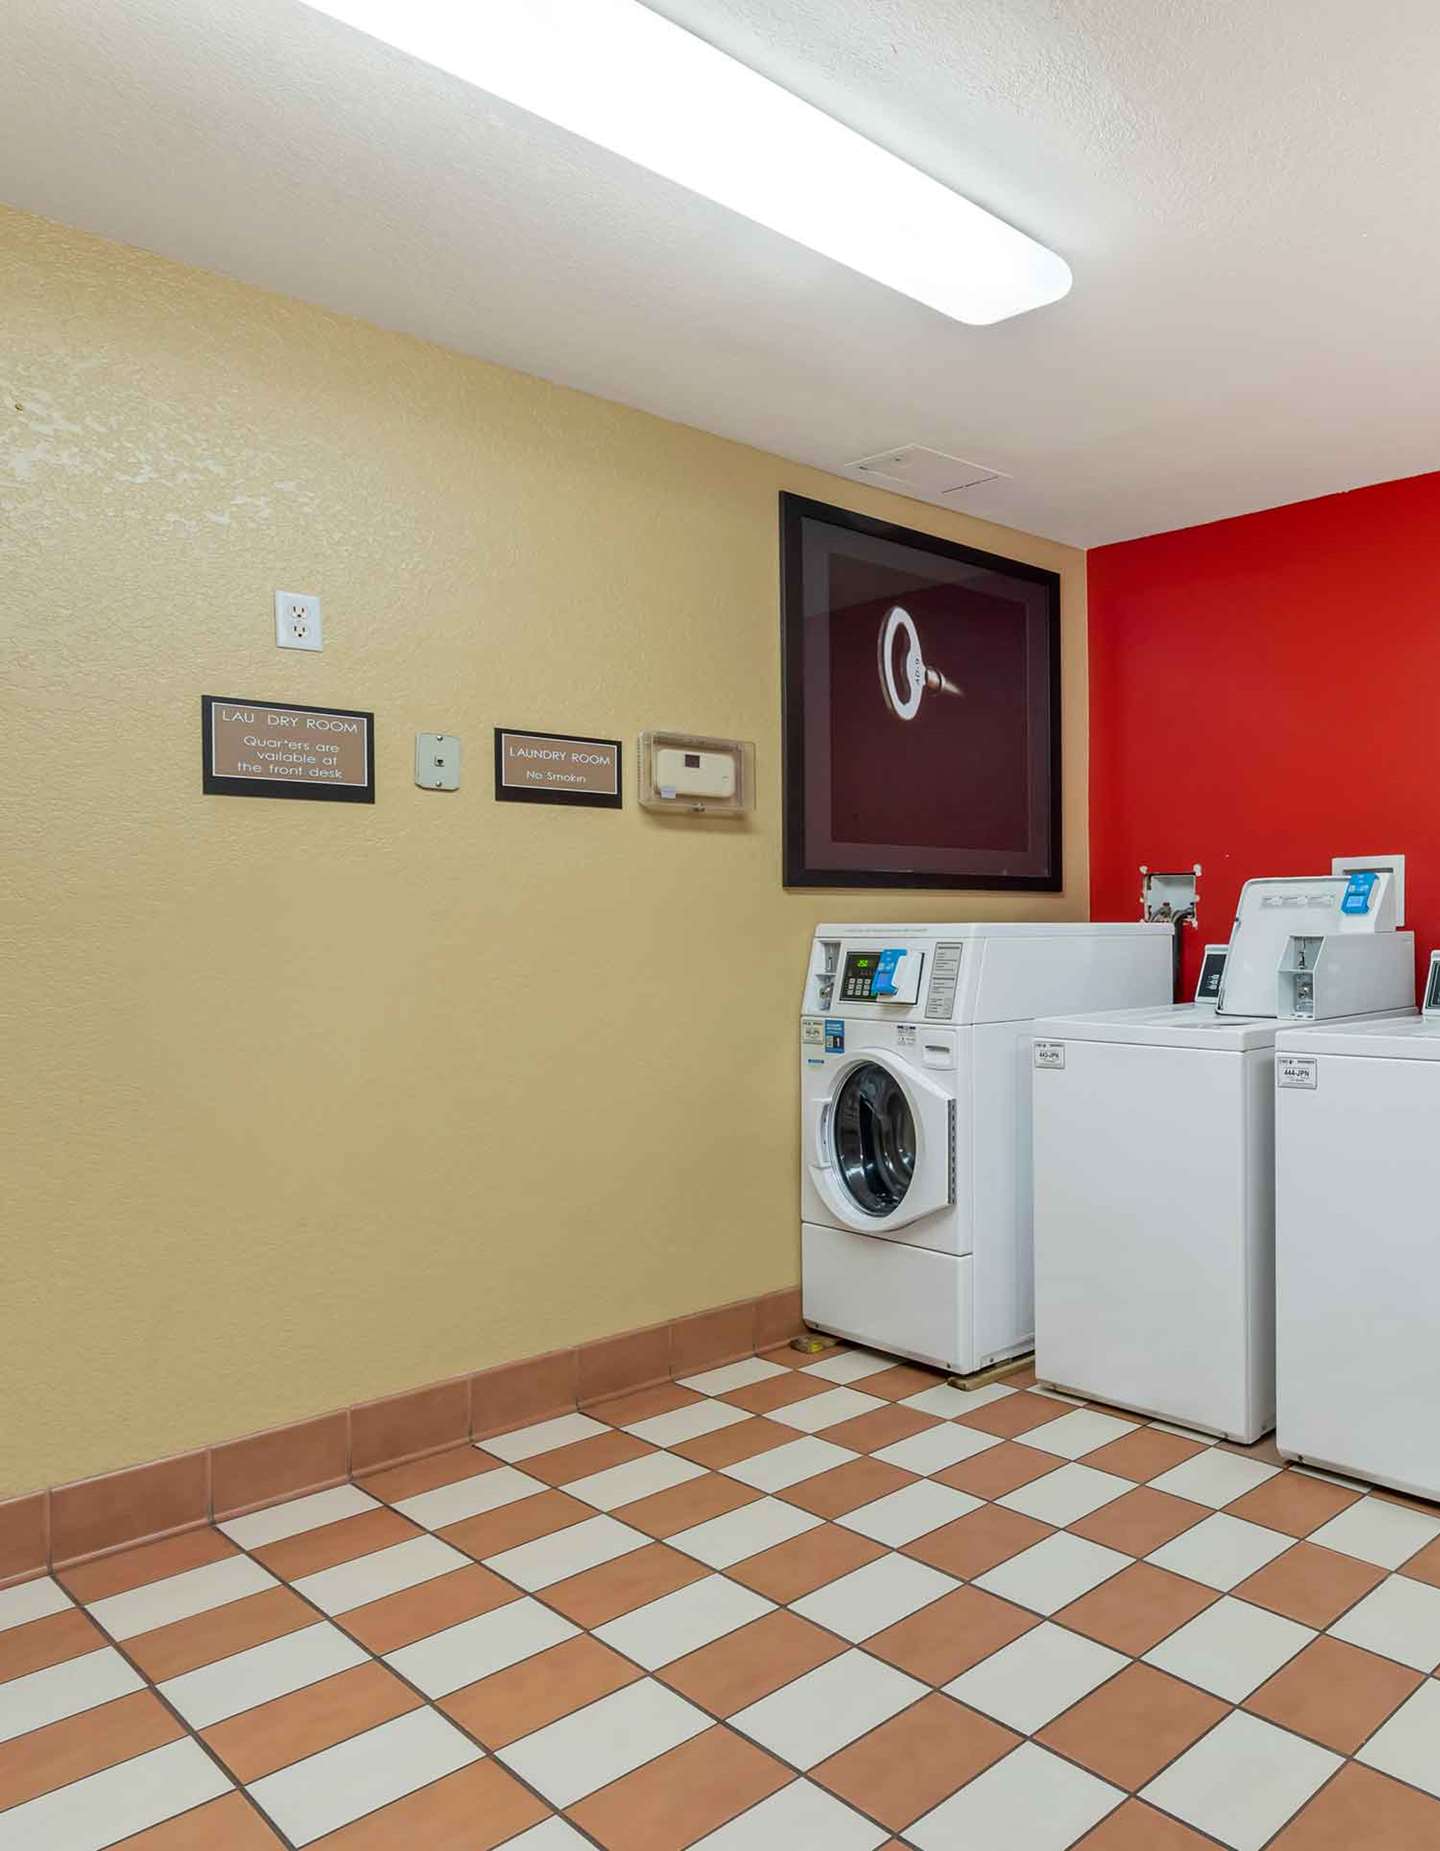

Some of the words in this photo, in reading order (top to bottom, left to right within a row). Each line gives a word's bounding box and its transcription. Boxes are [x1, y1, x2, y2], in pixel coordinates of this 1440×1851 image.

[306, 718, 358, 733] ROOM
[315, 745, 339, 753] are
[322, 755, 338, 765] at
[509, 747, 567, 761] LAUNDRY
[571, 752, 611, 765] ROOM
[237, 761, 262, 773] the
[269, 764, 303, 777] front
[308, 768, 344, 779] desk
[526, 771, 543, 780] No
